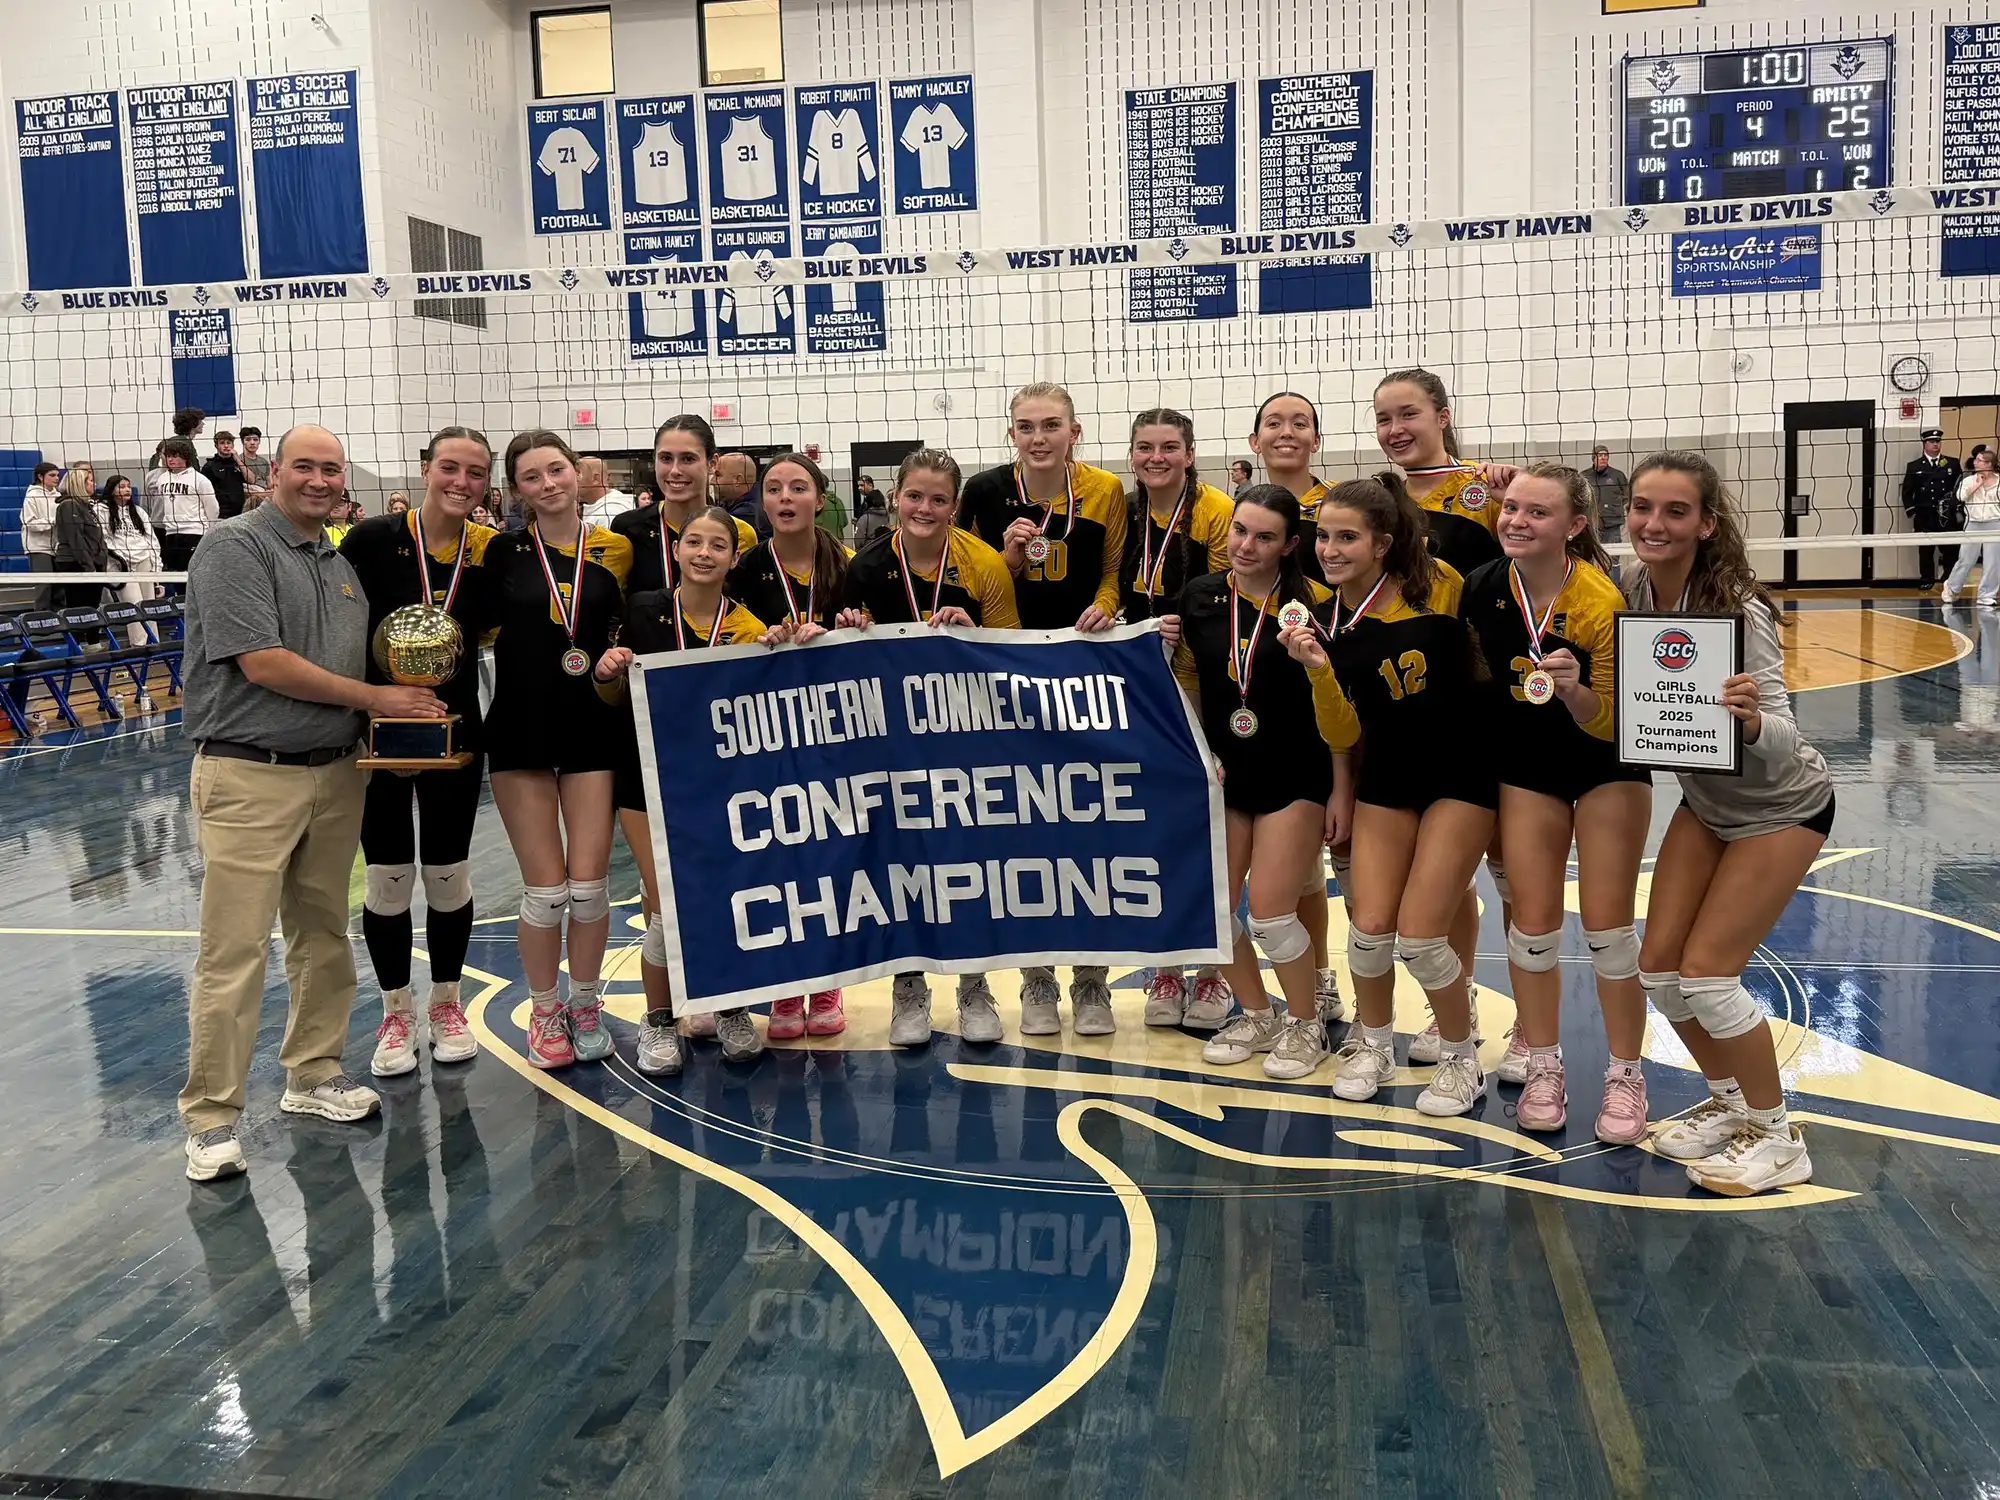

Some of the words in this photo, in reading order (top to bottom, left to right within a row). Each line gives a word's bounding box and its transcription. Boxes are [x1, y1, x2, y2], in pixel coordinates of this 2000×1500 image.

[1976, 27, 2000, 42] BLUE
[1955, 44, 1981, 59] 1,000
[1744, 52, 1803, 84] 1:00
[1947, 64, 1978, 74] FRANK
[257, 78, 290, 95] BOYS
[295, 74, 346, 90] SOCCER
[1280, 74, 1350, 91] SOUTHERN
[1946, 75, 1985, 86] KELLEY
[129, 87, 185, 105] OUTDOOR
[190, 83, 231, 100] TRACK
[801, 91, 831, 105] ROBERT
[835, 88, 870, 102] FUMIATTI
[892, 85, 922, 99] TAMMY
[927, 81, 969, 96] HACKLEY
[1135, 90, 1166, 105] STATE
[1171, 85, 1226, 102] CHAMPIONS
[1271, 86, 1360, 104] CONNECTICUT
[1813, 85, 1872, 103] AMITY
[1946, 88, 1978, 98] RUFUS
[23, 99, 66, 115] INDOOR
[70, 94, 110, 111] TRACK
[257, 93, 299, 111] ALL-NEW
[303, 90, 348, 106] ENGLAND
[624, 102, 658, 116] KELLEY
[662, 101, 686, 114] CAMP
[708, 98, 740, 111] MICHAEL
[1273, 99, 1359, 116] CONFERENCE
[1650, 97, 1685, 114] SHA
[1737, 101, 1772, 112] PERIOD
[137, 103, 179, 120] ALL-NEW
[182, 99, 227, 116] ENGLAND
[536, 110, 558, 123] BERT
[563, 107, 596, 121] SICLARI
[1128, 110, 1148, 119] 1949
[1151, 108, 1173, 118] BOYS
[1176, 106, 1188, 116] ICE
[1191, 104, 1224, 115] HOCKEY
[25, 114, 65, 130] ALL-NEW
[68, 109, 112, 126] ENGLAND
[251, 117, 272, 127] 2013
[274, 114, 300, 125] PABLO
[302, 112, 330, 122] PEREZ
[1272, 111, 1359, 131] CHAMPIONS
[1747, 116, 1763, 138] 4
[1828, 105, 1869, 138] 25
[132, 126, 152, 136] 1988
[155, 124, 181, 135] SHAWN
[183, 121, 211, 132] BROWN
[252, 128, 273, 138] 2016
[275, 125, 302, 136] SALAH
[923, 125, 942, 143] 13
[1651, 117, 1690, 149] 20
[1945, 124, 1970, 133] PAUL
[20, 136, 39, 146] 2009
[42, 135, 57, 145] ADA
[133, 137, 153, 147] 1996
[155, 135, 184, 146] CARLIN
[185, 131, 225, 143] GUARNERI
[253, 140, 274, 149] 2020
[276, 136, 297, 148] ALDO
[300, 134, 344, 145] BARRAGAN
[832, 133, 842, 149] 8
[1261, 138, 1282, 147] 2003
[1285, 134, 1329, 145] BASEBALL
[20, 147, 39, 157] 2016
[42, 145, 64, 156] JEFFREY
[558, 147, 576, 163] 71
[649, 151, 668, 167] 13
[738, 145, 758, 161] 31
[1733, 150, 1779, 167] MATCH
[1801, 151, 1829, 161] T.O.L.
[1843, 144, 1871, 160] WON
[1944, 146, 1984, 156] CATRINA
[1261, 159, 1282, 168] 2010
[1285, 155, 1309, 165] GIRLS
[1312, 152, 1352, 164] SWIMMING
[1639, 158, 1665, 173] WON
[1681, 159, 1708, 169] T.O.L.
[137, 182, 156, 191] 2016
[159, 180, 184, 190] TALON
[186, 177, 218, 188] BUTLER
[1816, 170, 1823, 191] 1
[1853, 165, 1869, 190] 2
[1659, 179, 1664, 199] 1
[1686, 175, 1701, 199] 0
[139, 203, 158, 214] 2016
[195, 199, 222, 210] AREMU
[805, 202, 823, 215] ICE
[827, 199, 875, 214] HOCKEY
[903, 193, 968, 209] SOFTBALL
[624, 209, 699, 224] BASKETBALL
[712, 204, 788, 220] BASKETBALL
[541, 214, 602, 229] FOOTBALL
[717, 233, 744, 246] CARLIN
[747, 231, 784, 244] GUARNERI
[806, 227, 826, 240] JERRY
[830, 224, 877, 239] GAMBARDELLA
[62, 293, 106, 309] BLUE
[109, 290, 168, 308] DEVILS
[234, 284, 283, 302] WEST
[290, 282, 346, 300] HAVEN
[417, 277, 462, 294] BLUE
[468, 274, 531, 292] DEVILS
[605, 268, 659, 286] WEST
[665, 265, 728, 284] HAVEN
[804, 259, 853, 278] BLUE
[859, 256, 926, 276] DEVILS
[1006, 250, 1064, 269] WEST
[1070, 245, 1137, 266] HAVEN
[1220, 235, 1274, 256] BLUE
[1280, 230, 1355, 252] DEVILS
[1445, 220, 1512, 241] WEST
[1516, 215, 1591, 237] HAVEN
[1684, 205, 1743, 226] BLUE
[1750, 197, 1832, 221] DEVILS
[1930, 187, 2000, 209] WEST
[630, 237, 662, 250] CATRINA
[665, 235, 695, 248] HAWLEY
[1677, 240, 1727, 261] Class
[1730, 237, 1775, 260] Act
[1677, 260, 1776, 273] SPORTSMANSHIP
[175, 315, 224, 331] SOCCER
[815, 312, 876, 325] BASEBALL
[809, 324, 884, 338] BASKETBALL
[632, 340, 706, 356] BASKETBALL
[722, 338, 791, 352] SOCCER
[816, 338, 878, 350] FOOTBALL
[1656, 643, 1694, 658] SCC
[1378, 649, 1427, 700] 12
[1530, 683, 1546, 692] SCC
[1657, 681, 1696, 692] GIRLS
[1634, 692, 1720, 705] VOLLEYBALL
[711, 677, 887, 760] SOUTHERN
[902, 672, 1130, 735] CONNECTICUT
[1659, 711, 1692, 722] 2025
[1637, 724, 1716, 738] Tournament
[1635, 739, 1718, 754] Champions
[727, 761, 1146, 852] CONFERENCE
[730, 856, 1162, 952] CHAMPIONS
